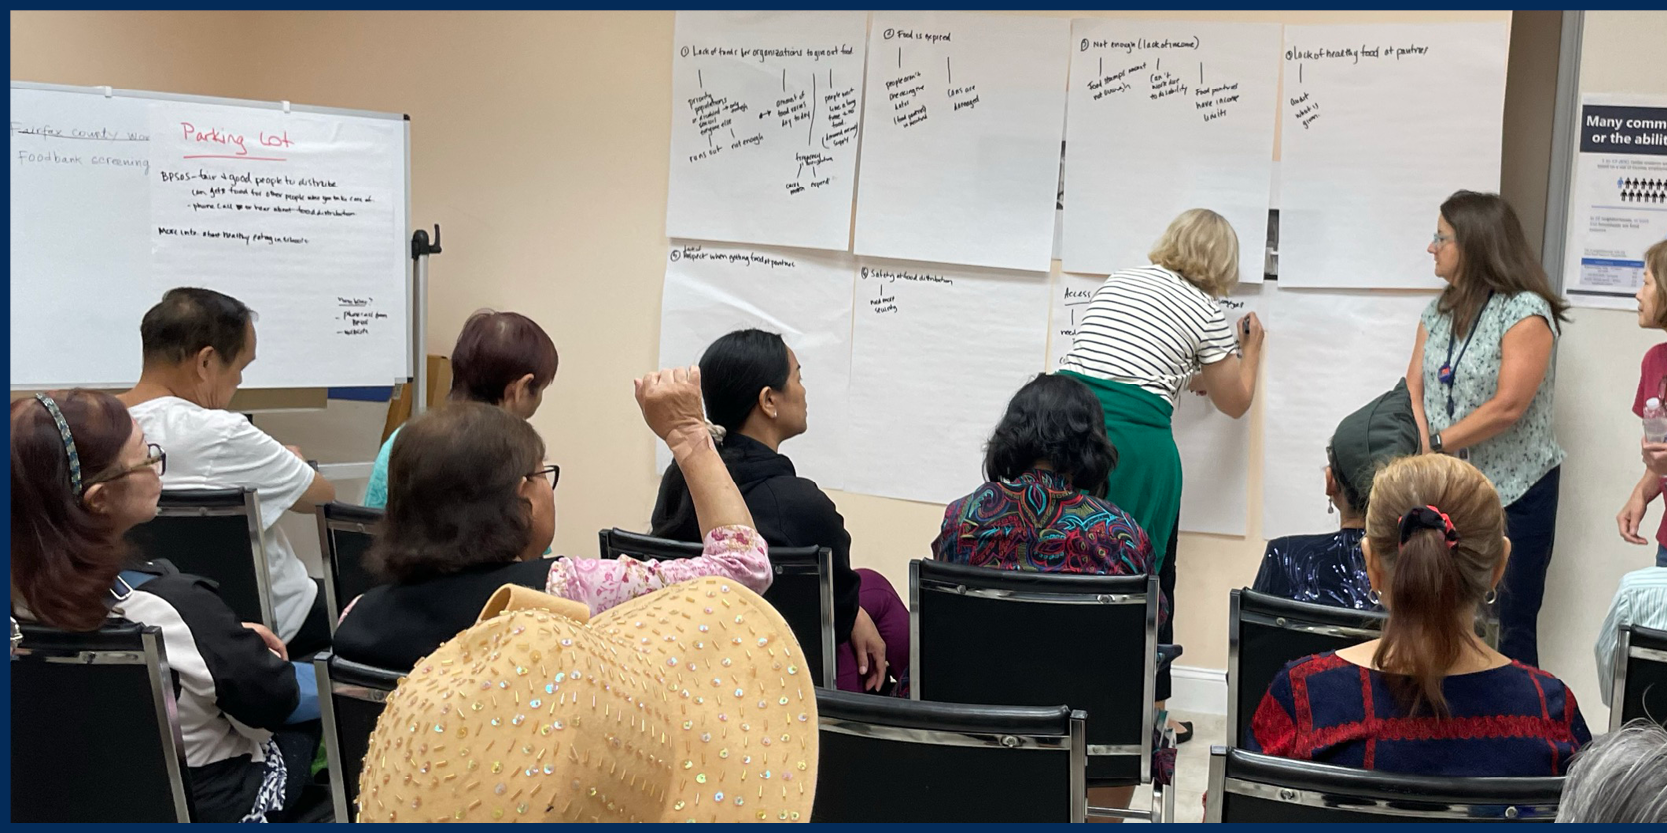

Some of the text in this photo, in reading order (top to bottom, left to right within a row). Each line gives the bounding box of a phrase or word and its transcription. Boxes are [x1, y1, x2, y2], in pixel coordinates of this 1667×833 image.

[897, 29, 913, 40] Food
[1110, 40, 1136, 53] enough
[752, 46, 803, 63] organizations
[1326, 48, 1359, 65] healthy
[1586, 115, 1623, 130] Many
[181, 121, 295, 155] Parking Lot
[1592, 134, 1607, 143] or
[1610, 132, 1632, 144] the
[18, 150, 150, 176] Foodbank screening
[229, 172, 252, 187] good
[255, 177, 282, 187] people
[870, 268, 896, 284] Safety
[1064, 286, 1092, 299] Access
